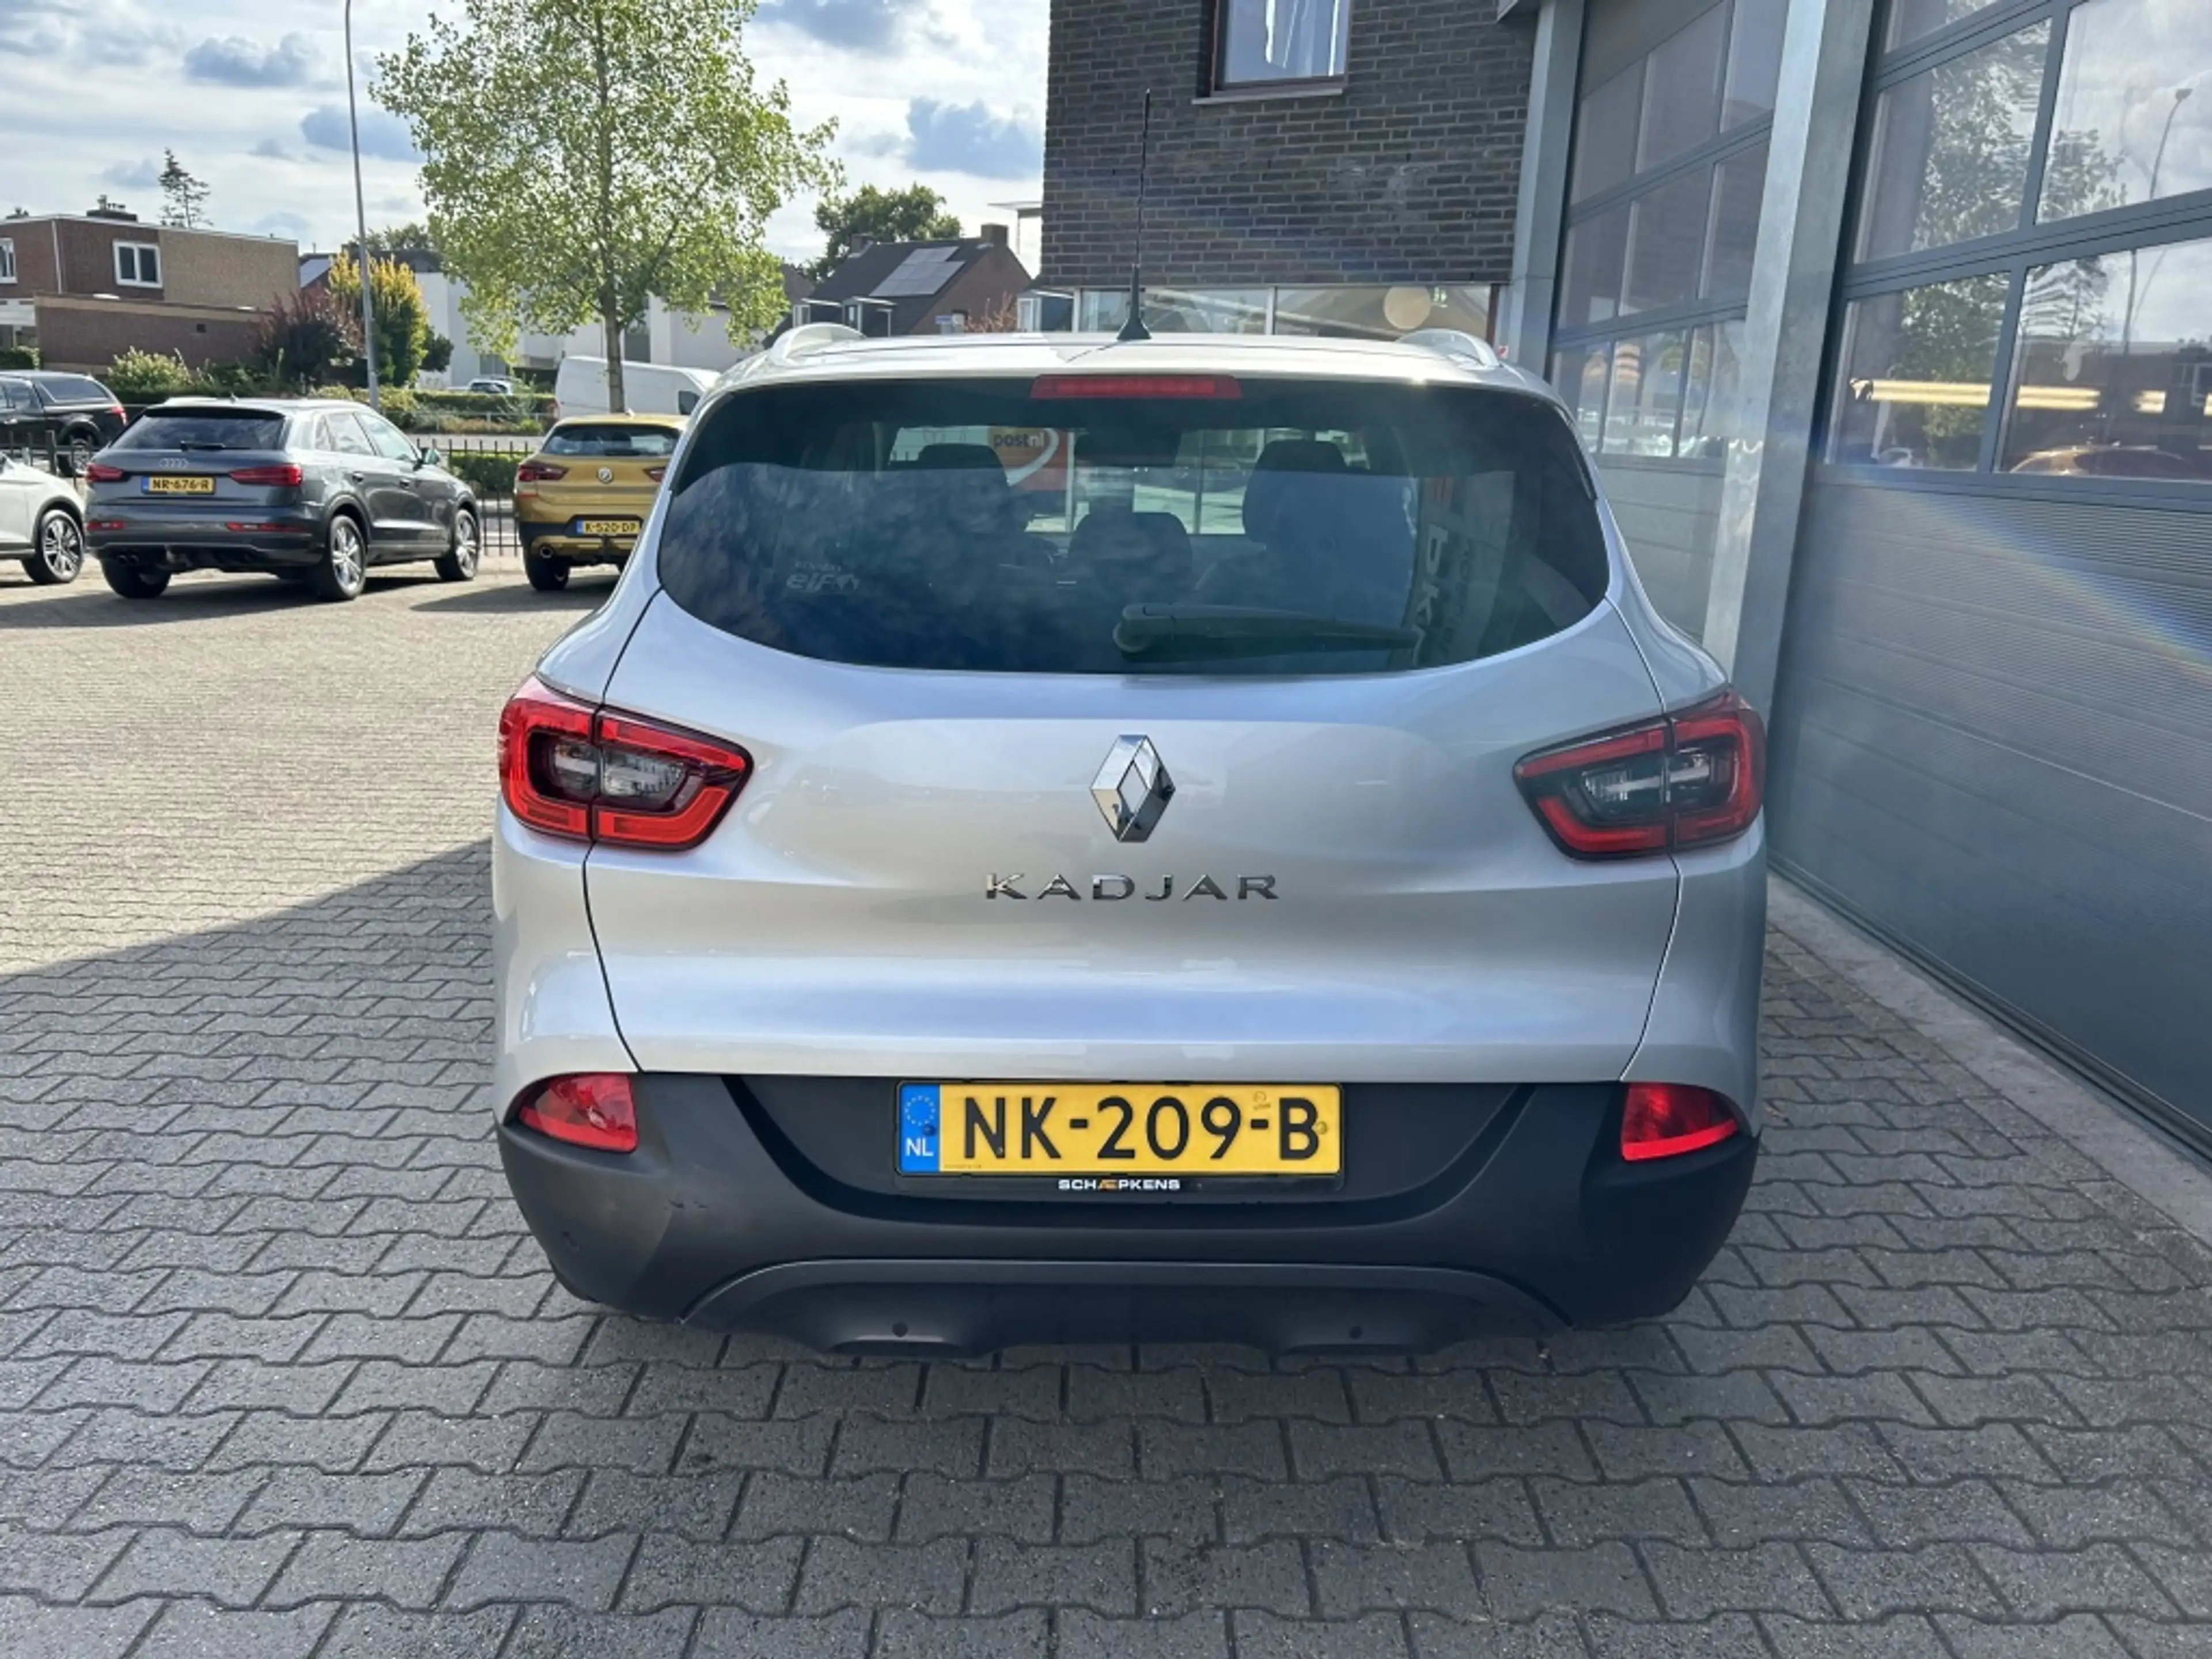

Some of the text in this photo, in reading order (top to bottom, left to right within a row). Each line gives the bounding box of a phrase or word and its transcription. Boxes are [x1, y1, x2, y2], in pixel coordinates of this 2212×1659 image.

[994, 432, 1044, 449] postnl
[152, 479, 209, 490] NR-676-R
[984, 874, 1279, 900] KADJAR
[964, 1096, 1319, 1160] NK-209-B
[906, 1137, 934, 1157] NL
